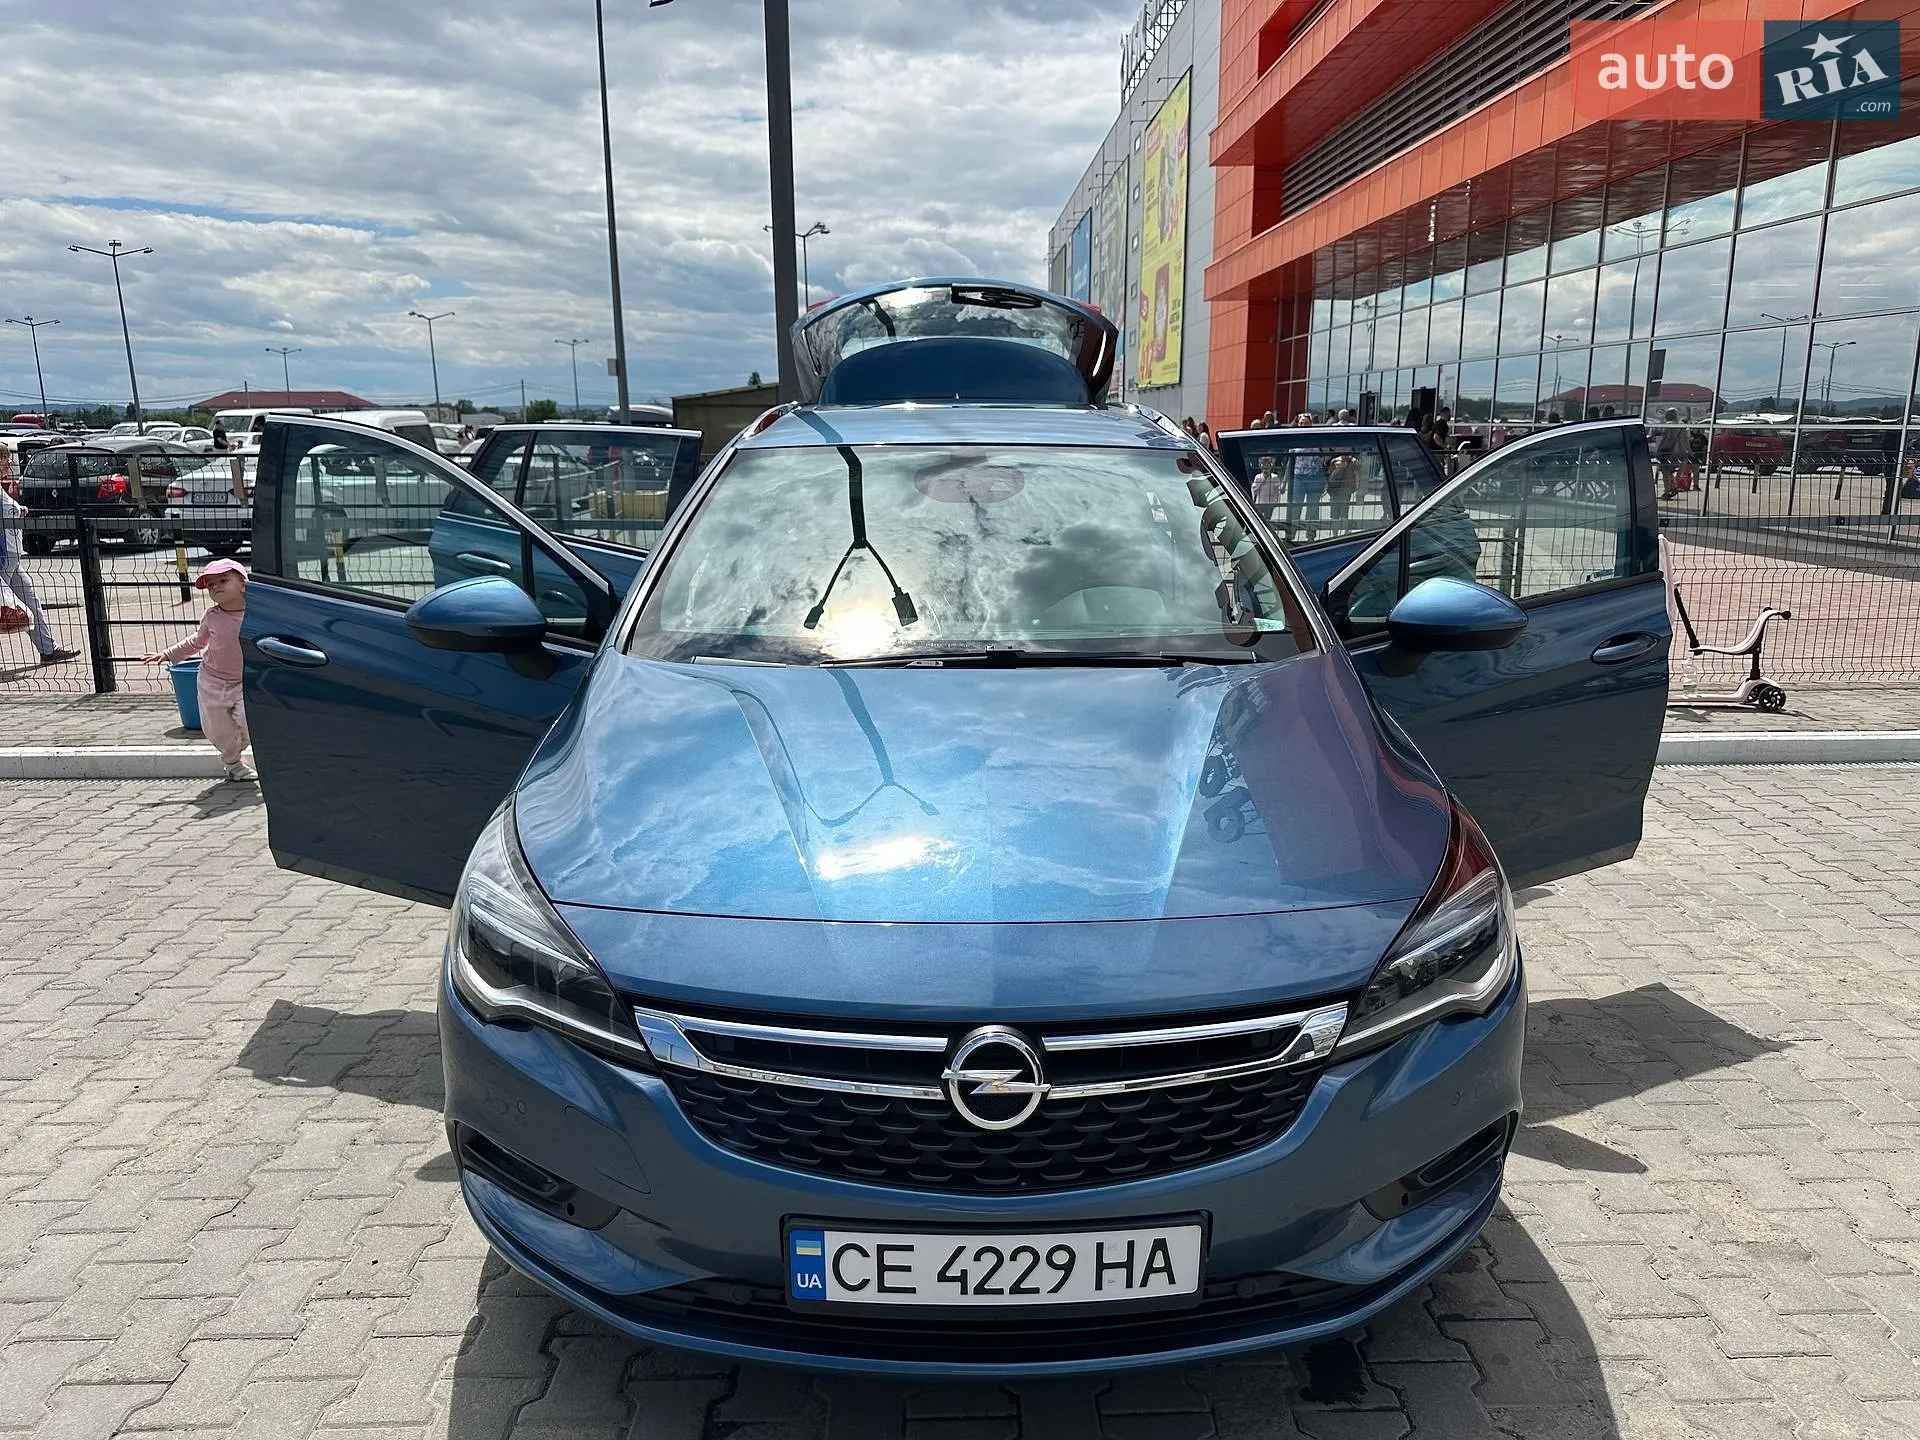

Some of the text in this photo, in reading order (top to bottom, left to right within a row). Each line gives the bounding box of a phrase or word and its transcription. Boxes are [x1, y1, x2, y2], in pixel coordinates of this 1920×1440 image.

[796, 1272, 822, 1290] UA
[830, 1237, 1177, 1295] CE 4229 HA
